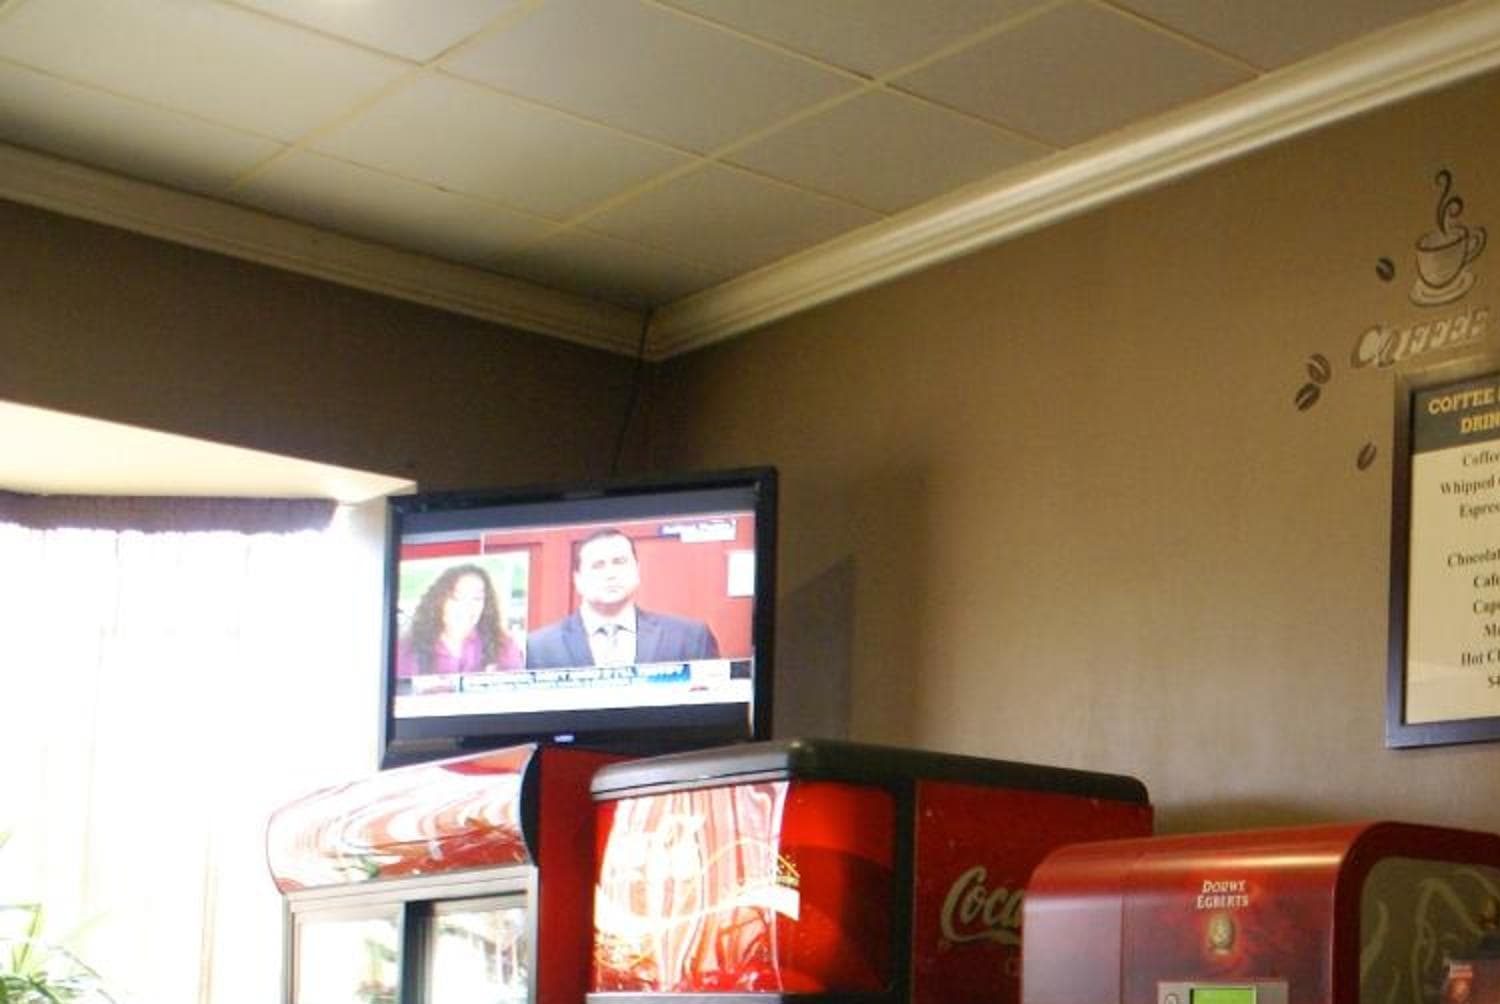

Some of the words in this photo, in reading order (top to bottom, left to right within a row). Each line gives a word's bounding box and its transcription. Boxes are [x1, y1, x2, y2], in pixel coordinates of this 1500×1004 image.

[1428, 387, 1495, 415] COFFEE
[1440, 474, 1495, 496] Whipped
[1461, 650, 1484, 667] Hot
